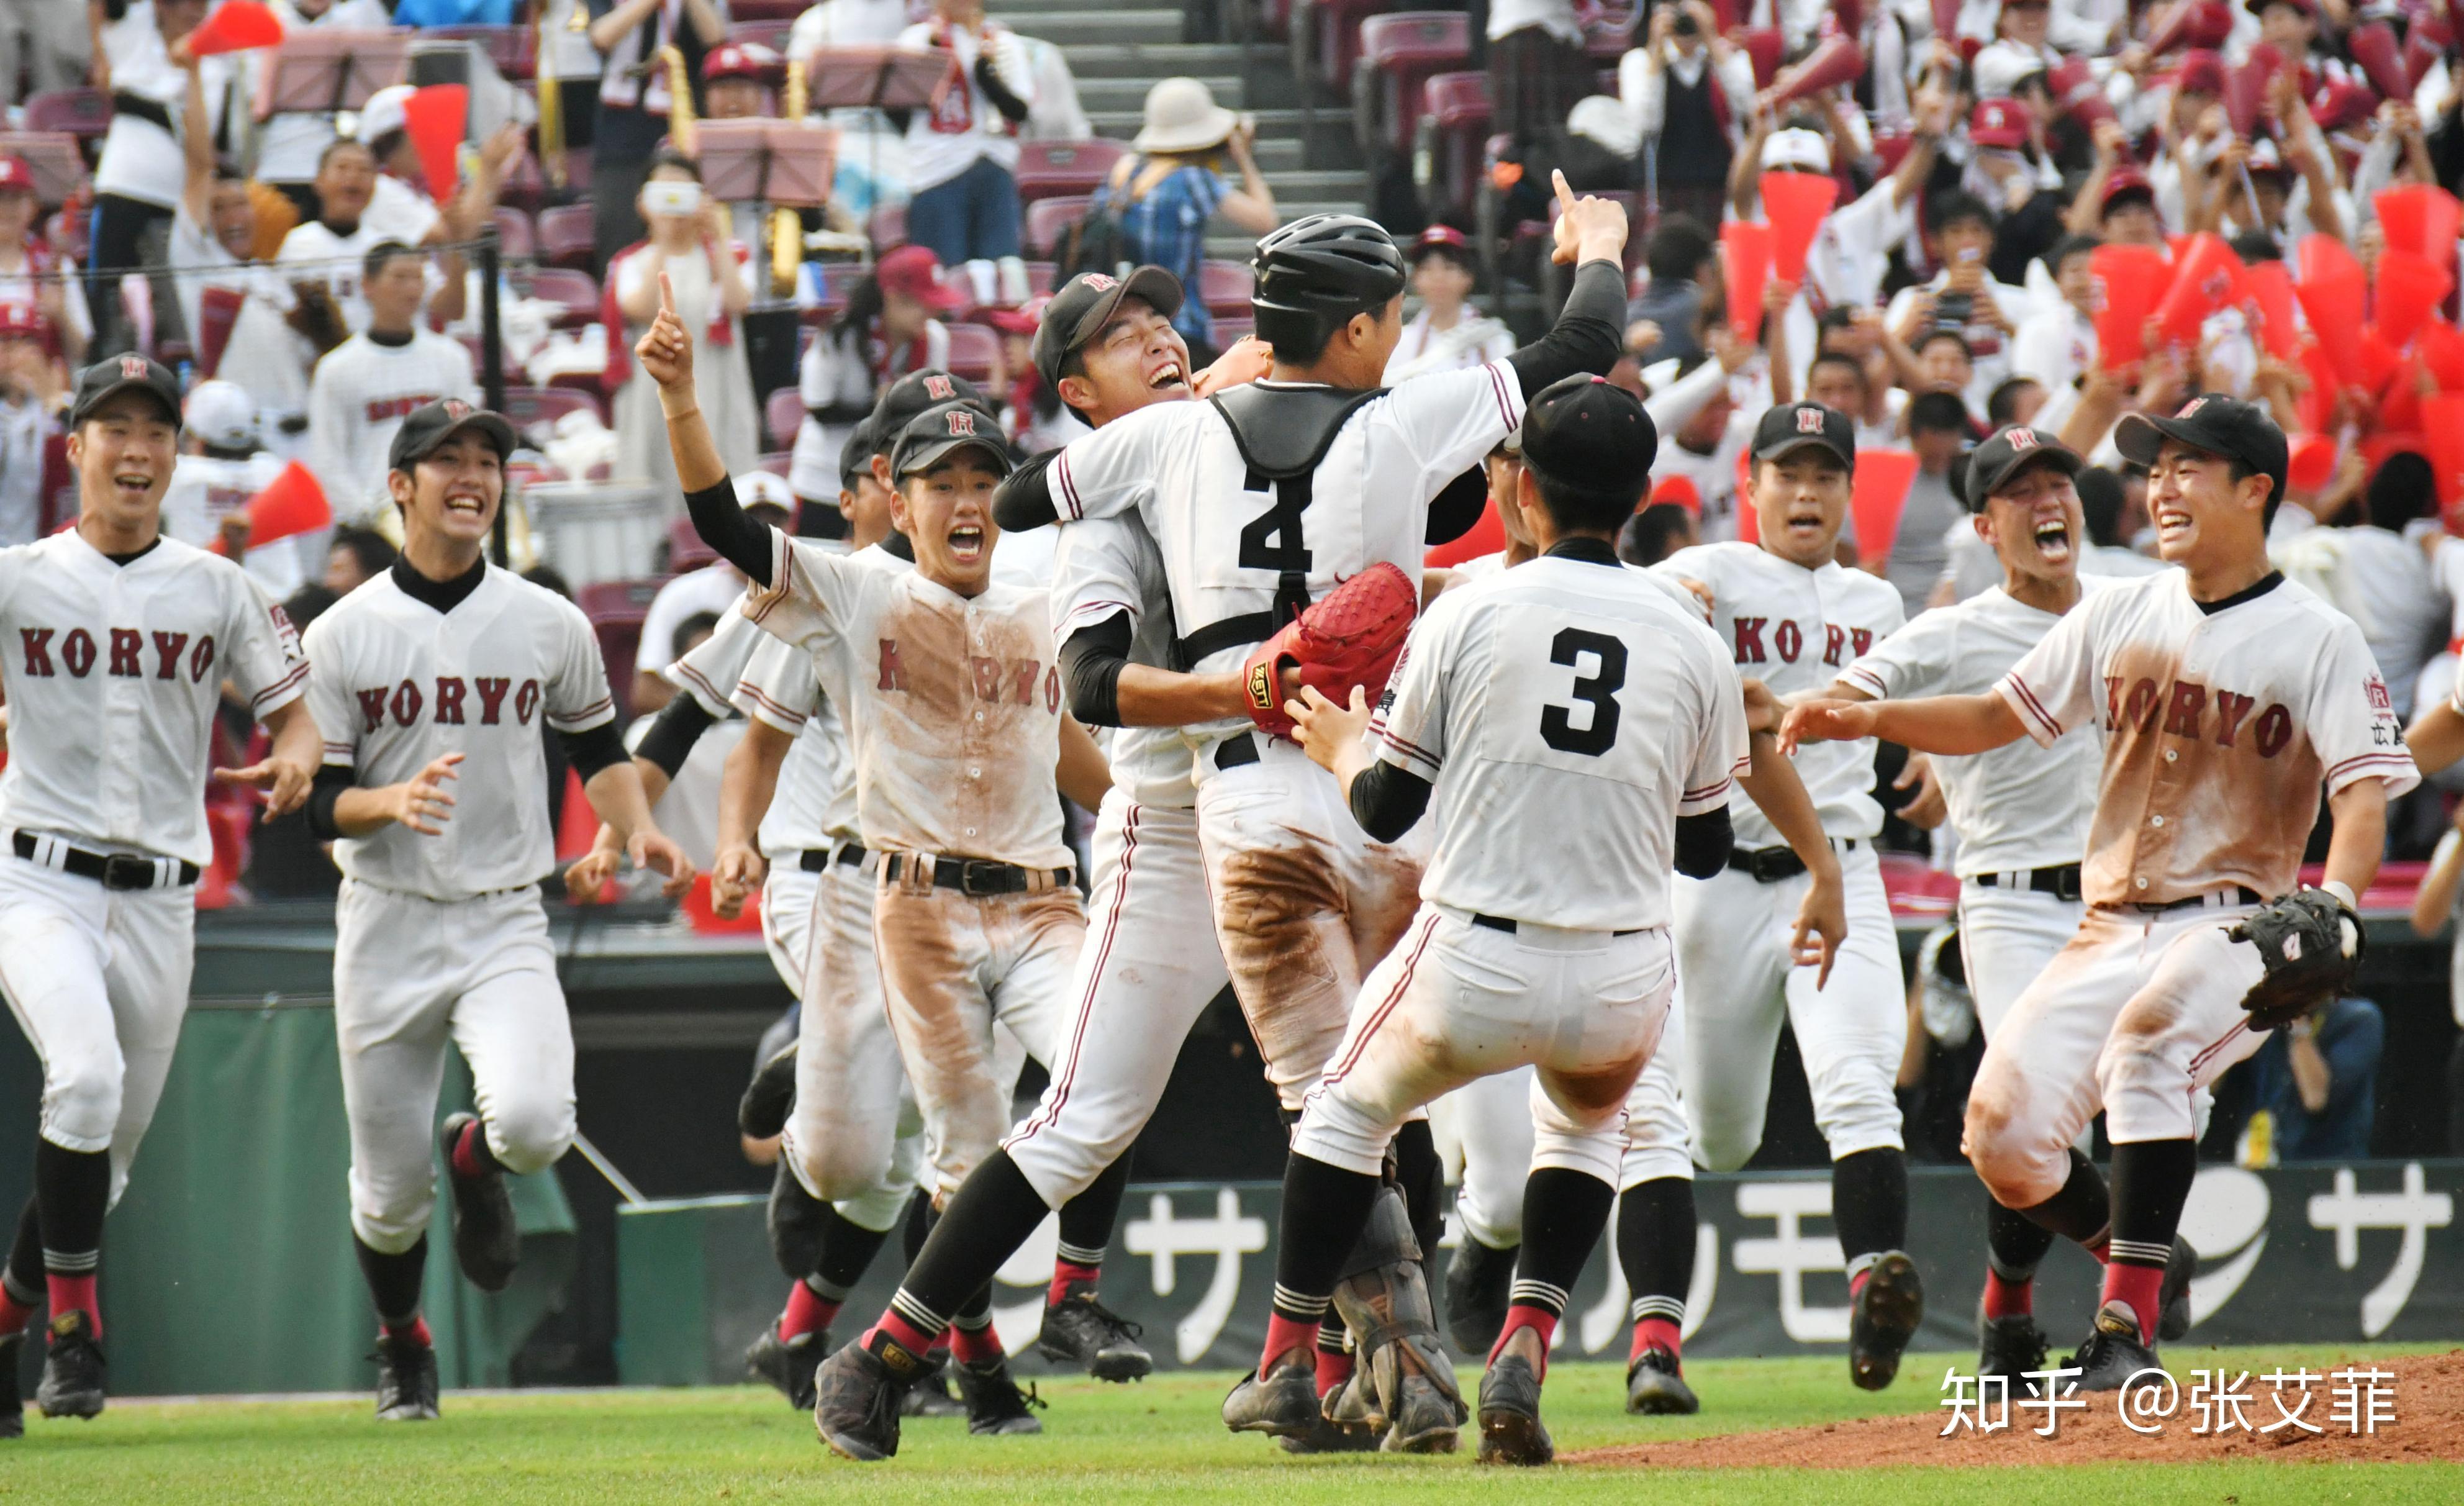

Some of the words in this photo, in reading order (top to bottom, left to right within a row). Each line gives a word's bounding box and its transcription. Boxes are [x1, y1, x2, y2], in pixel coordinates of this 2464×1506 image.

[19, 627, 217, 684] KORYO
[1733, 617, 1886, 668] KORY
[356, 676, 540, 734] KORYO
[877, 638, 1061, 715] KRYO
[1251, 666, 1269, 706] ZETT
[1539, 626, 1629, 758] 3
[2306, 1161, 2453, 1338] サ
